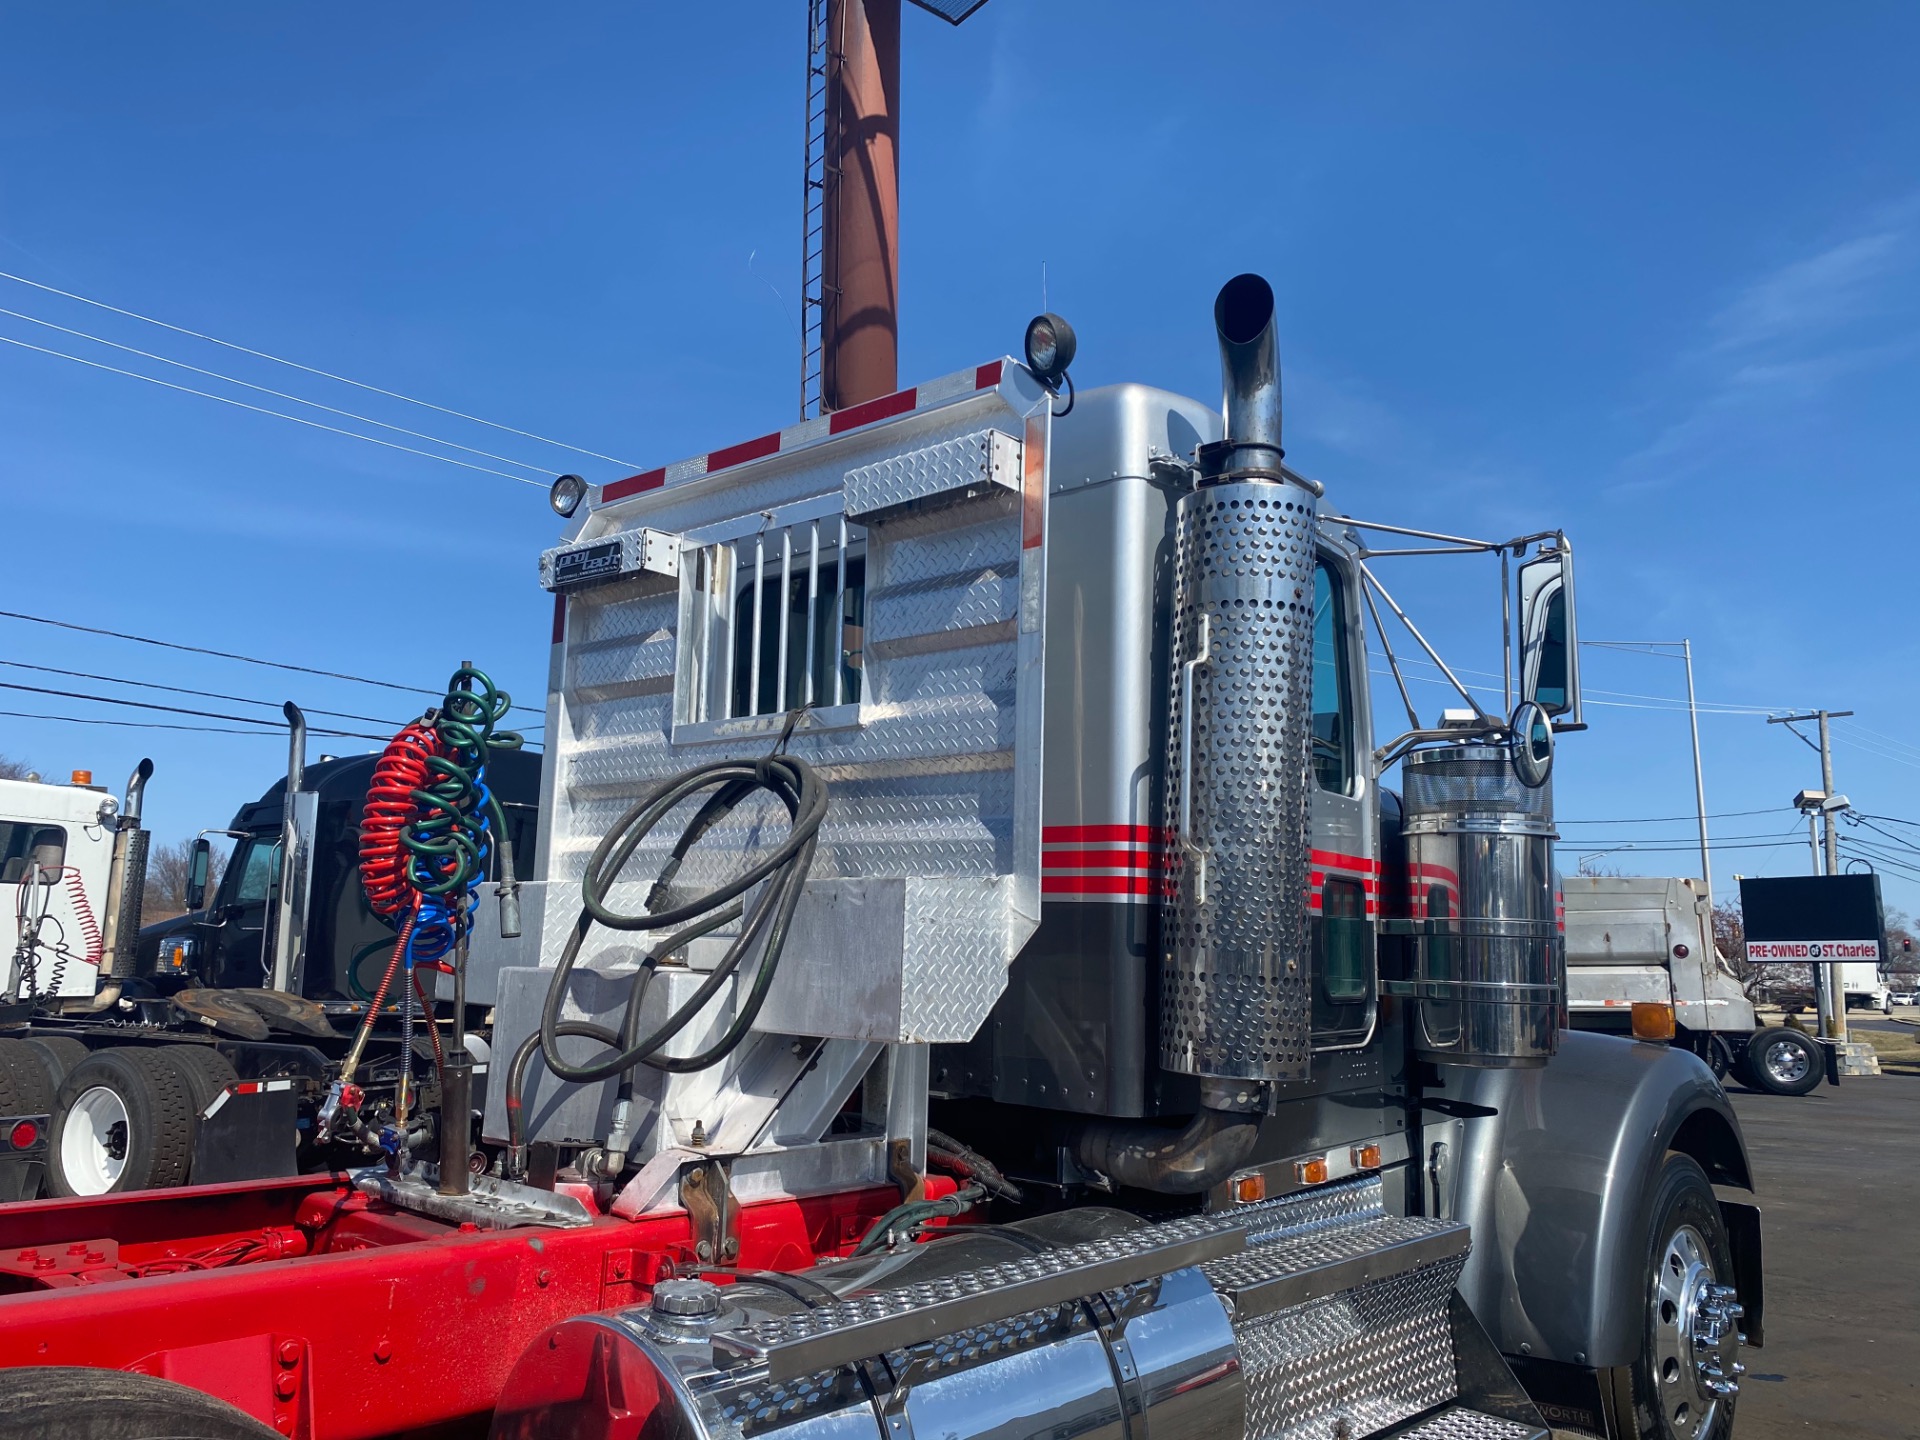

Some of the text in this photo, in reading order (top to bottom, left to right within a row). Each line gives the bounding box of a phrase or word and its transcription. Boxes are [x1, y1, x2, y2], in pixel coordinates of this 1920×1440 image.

[1749, 944, 1876, 957] PRE-OWNED of ST. Charles
